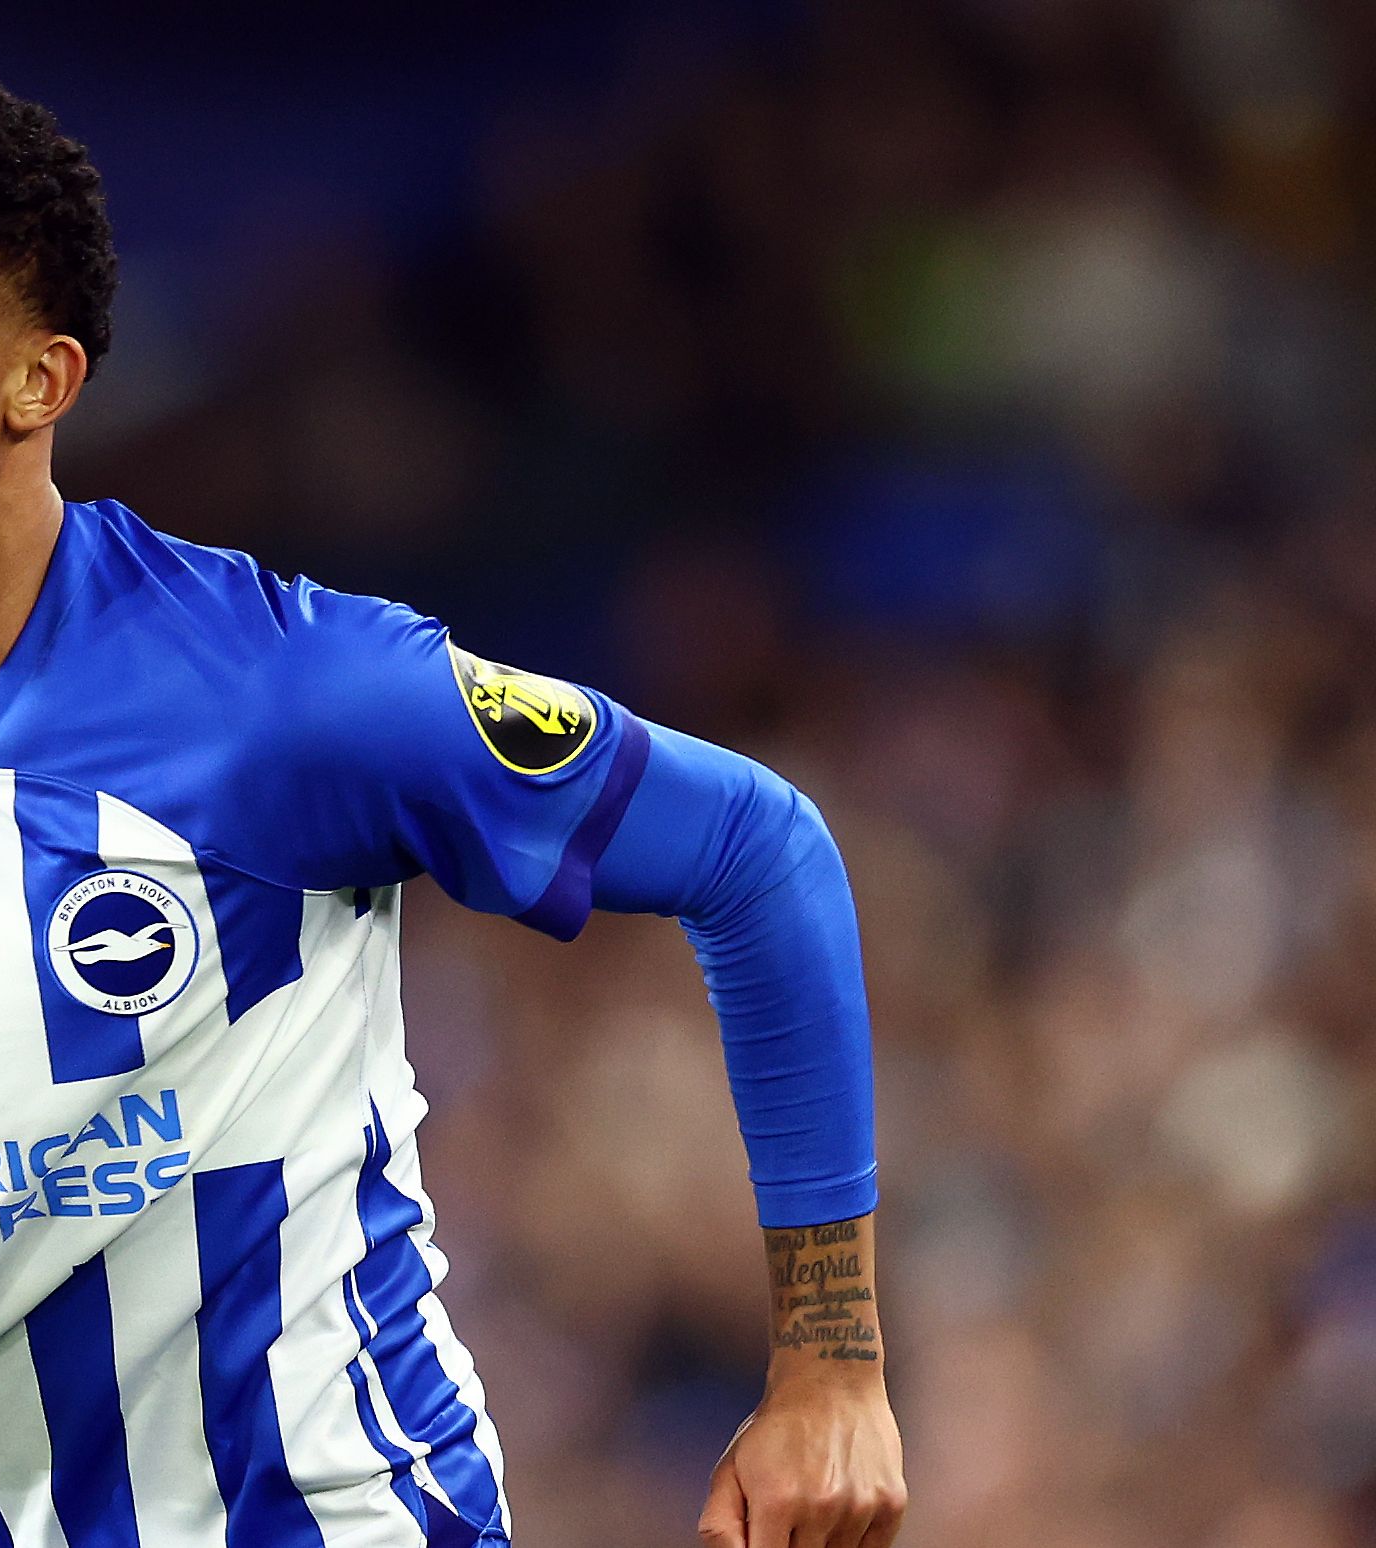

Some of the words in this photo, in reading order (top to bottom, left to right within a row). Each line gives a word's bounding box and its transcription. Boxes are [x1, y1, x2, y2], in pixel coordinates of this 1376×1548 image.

[59, 878, 115, 921] BRIGHTON
[123, 879, 131, 889] &
[139, 883, 172, 910] HOVE
[103, 993, 159, 1011] ALBION
[776, 1252, 862, 1290] alegria
